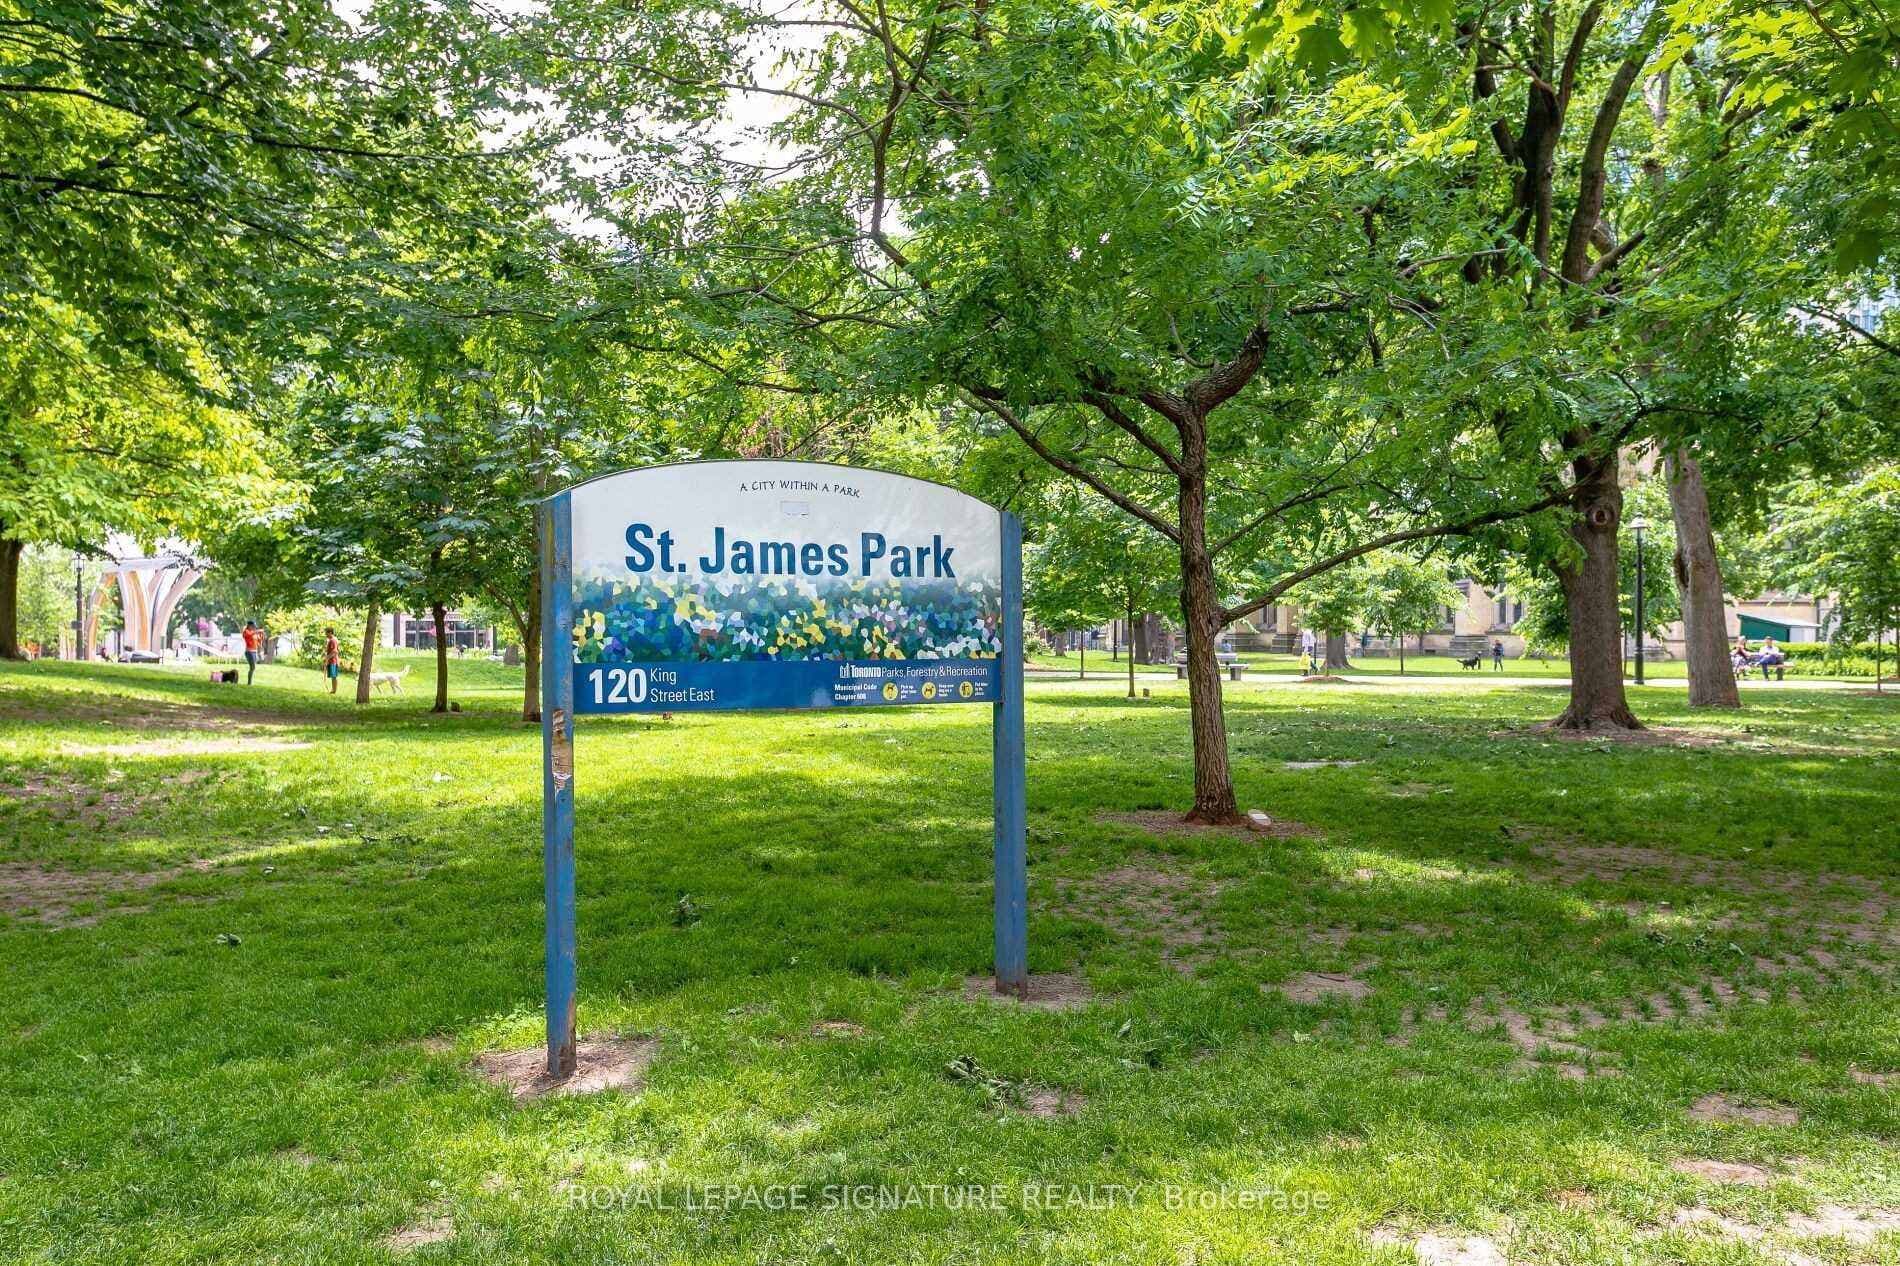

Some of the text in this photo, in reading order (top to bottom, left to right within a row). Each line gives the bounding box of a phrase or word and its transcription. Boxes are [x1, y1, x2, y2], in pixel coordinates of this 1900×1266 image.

[739, 480, 860, 498] A CITY WITHIN A PARK
[625, 523, 956, 578] St. James Park
[650, 668, 677, 685] King
[882, 666, 906, 679] Parks,
[906, 666, 939, 679] Forestry
[939, 666, 946, 677] &
[946, 665, 988, 677] Recreation
[589, 668, 647, 704] 120
[834, 683, 878, 693] Municipal Code
[650, 688, 715, 703] Street East
[834, 692, 856, 702] Chapter
